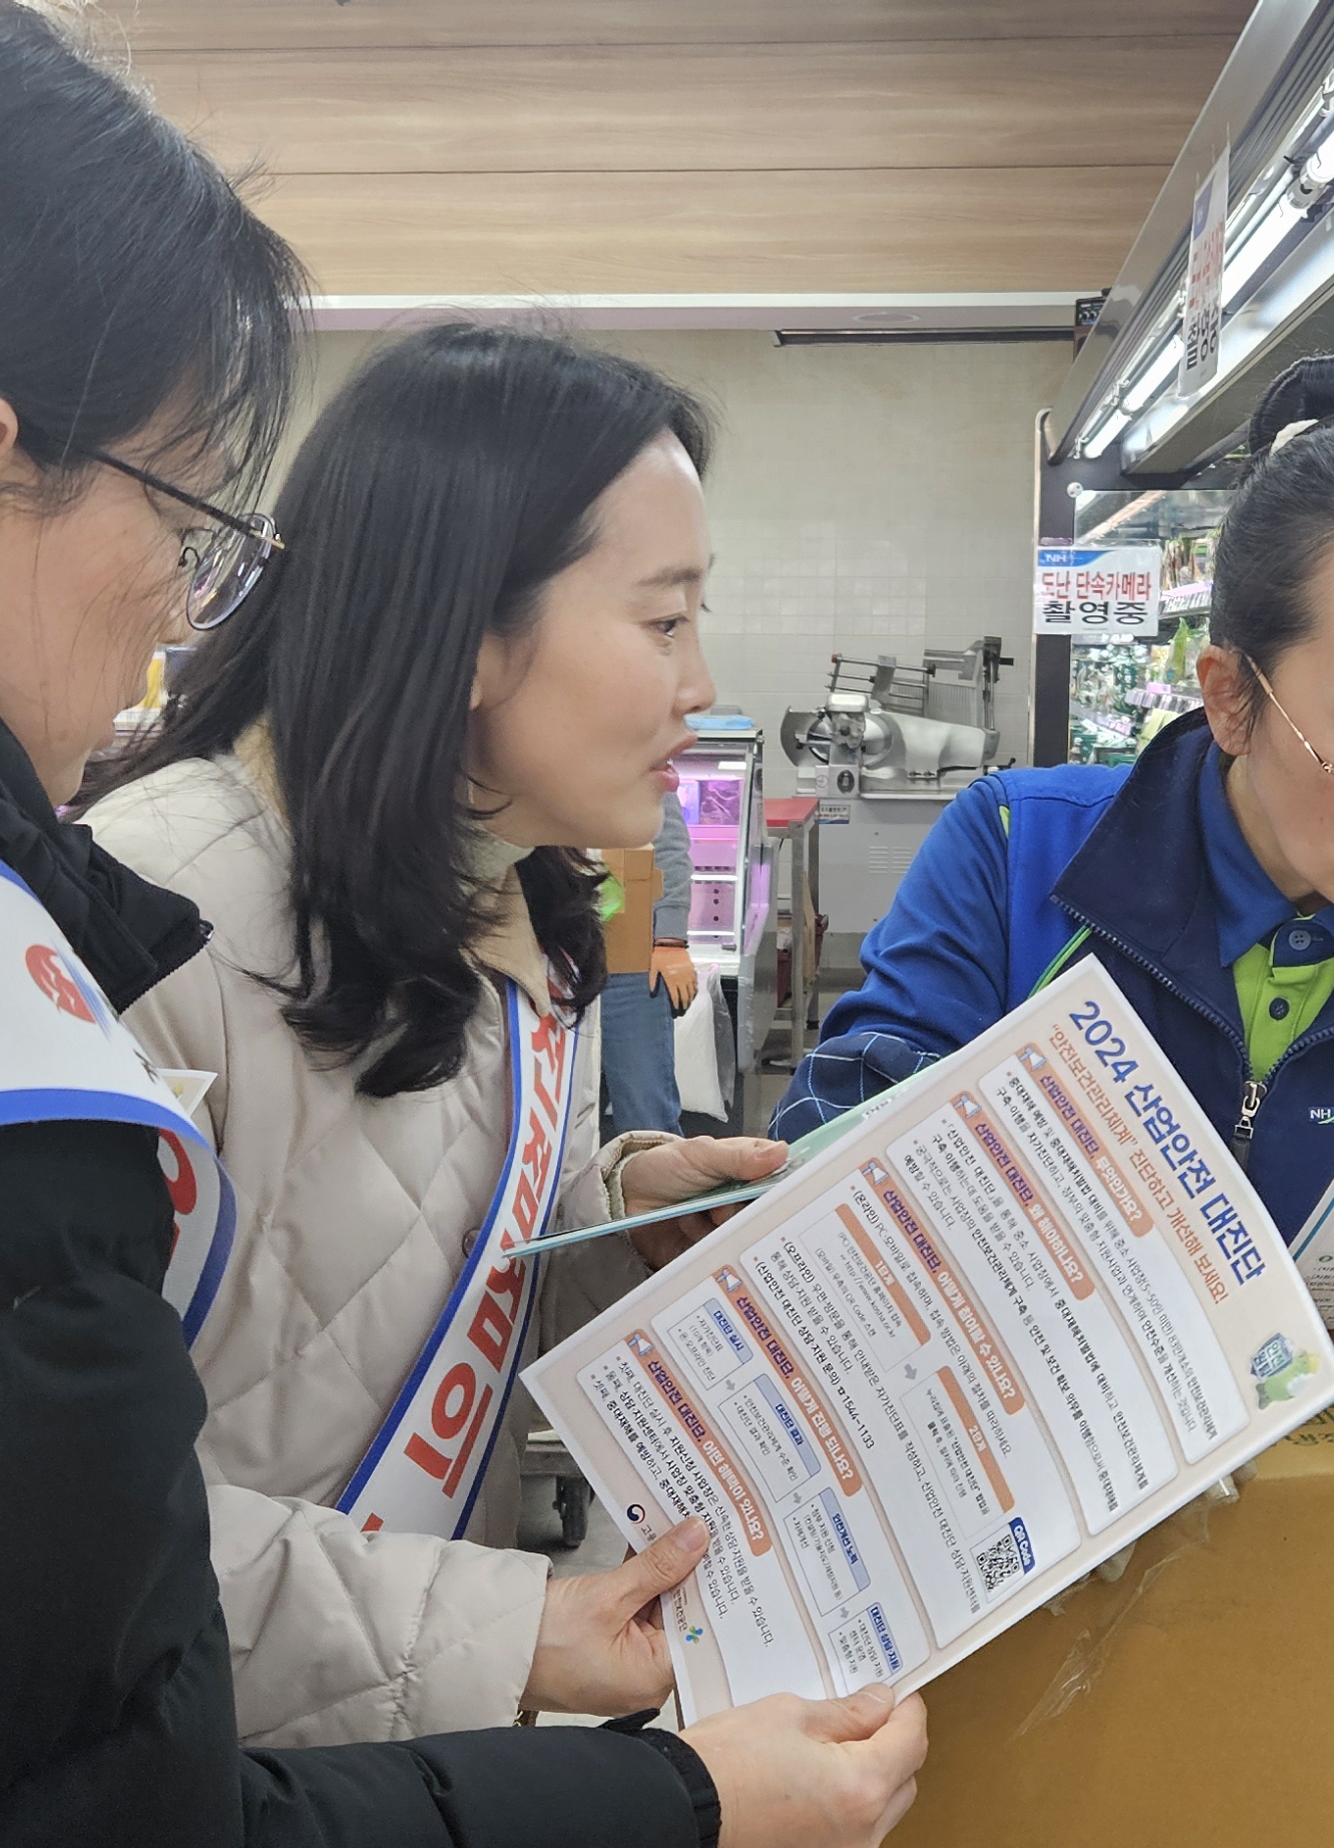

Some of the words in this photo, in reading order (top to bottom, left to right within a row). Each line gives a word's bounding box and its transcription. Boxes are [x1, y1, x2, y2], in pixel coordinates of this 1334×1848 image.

[1044, 553, 1068, 563] NH
[1042, 571, 1070, 599] 도난
[1076, 571, 1153, 601] 단속카메라
[1042, 600, 1149, 625] 촬영중
[1309, 1108, 1332, 1119] NH
[974, 1119, 1011, 1170] 산업안전
[1039, 1070, 1077, 1123] 산업안전
[1069, 1116, 1102, 1160] 대진단,
[1094, 1154, 1143, 1224] 무엇인가요?
[1068, 994, 1140, 1089] 2024
[1123, 1074, 1216, 1201] 산업안전
[1195, 1191, 1270, 1287] 대진단
[1044, 1018, 1138, 1156] “안전보건관리체계”
[1128, 1146, 1175, 1212] 진단하고
[1165, 1206, 1203, 1257] 개선해
[1191, 1253, 1230, 1305] 보세요!
[1003, 1164, 1036, 1208] 대진단,
[852, 1188, 880, 1226] (온라인)
[881, 1185, 919, 1237] 산업안전
[1028, 1202, 1045, 1220] 왜
[911, 1231, 943, 1274] 대진단,
[1035, 1215, 1084, 1285] 해야하나요?
[936, 1269, 965, 1309] 어떻게
[735, 1291, 772, 1344] 산업안전
[764, 1337, 796, 1380] 대진단,
[852, 1348, 880, 1387] 안내받은
[977, 1340, 993, 1357] 수
[780, 1297, 803, 1327] 대진단
[839, 1396, 875, 1450] 1544-1133
[982, 1354, 1018, 1401] 있나요?
[789, 1375, 818, 1414] 어떻게
[774, 1402, 794, 1430] 대진단
[811, 1410, 833, 1438] 진행
[647, 1356, 682, 1407] 산업안전
[701, 1438, 723, 1467] 어떤
[716, 1461, 745, 1502] 혜택이
[734, 1498, 767, 1542] 있나요?
[821, 1435, 855, 1482] 되나요?
[1010, 1524, 1027, 1543] QR
[1014, 1539, 1036, 1565] Code
